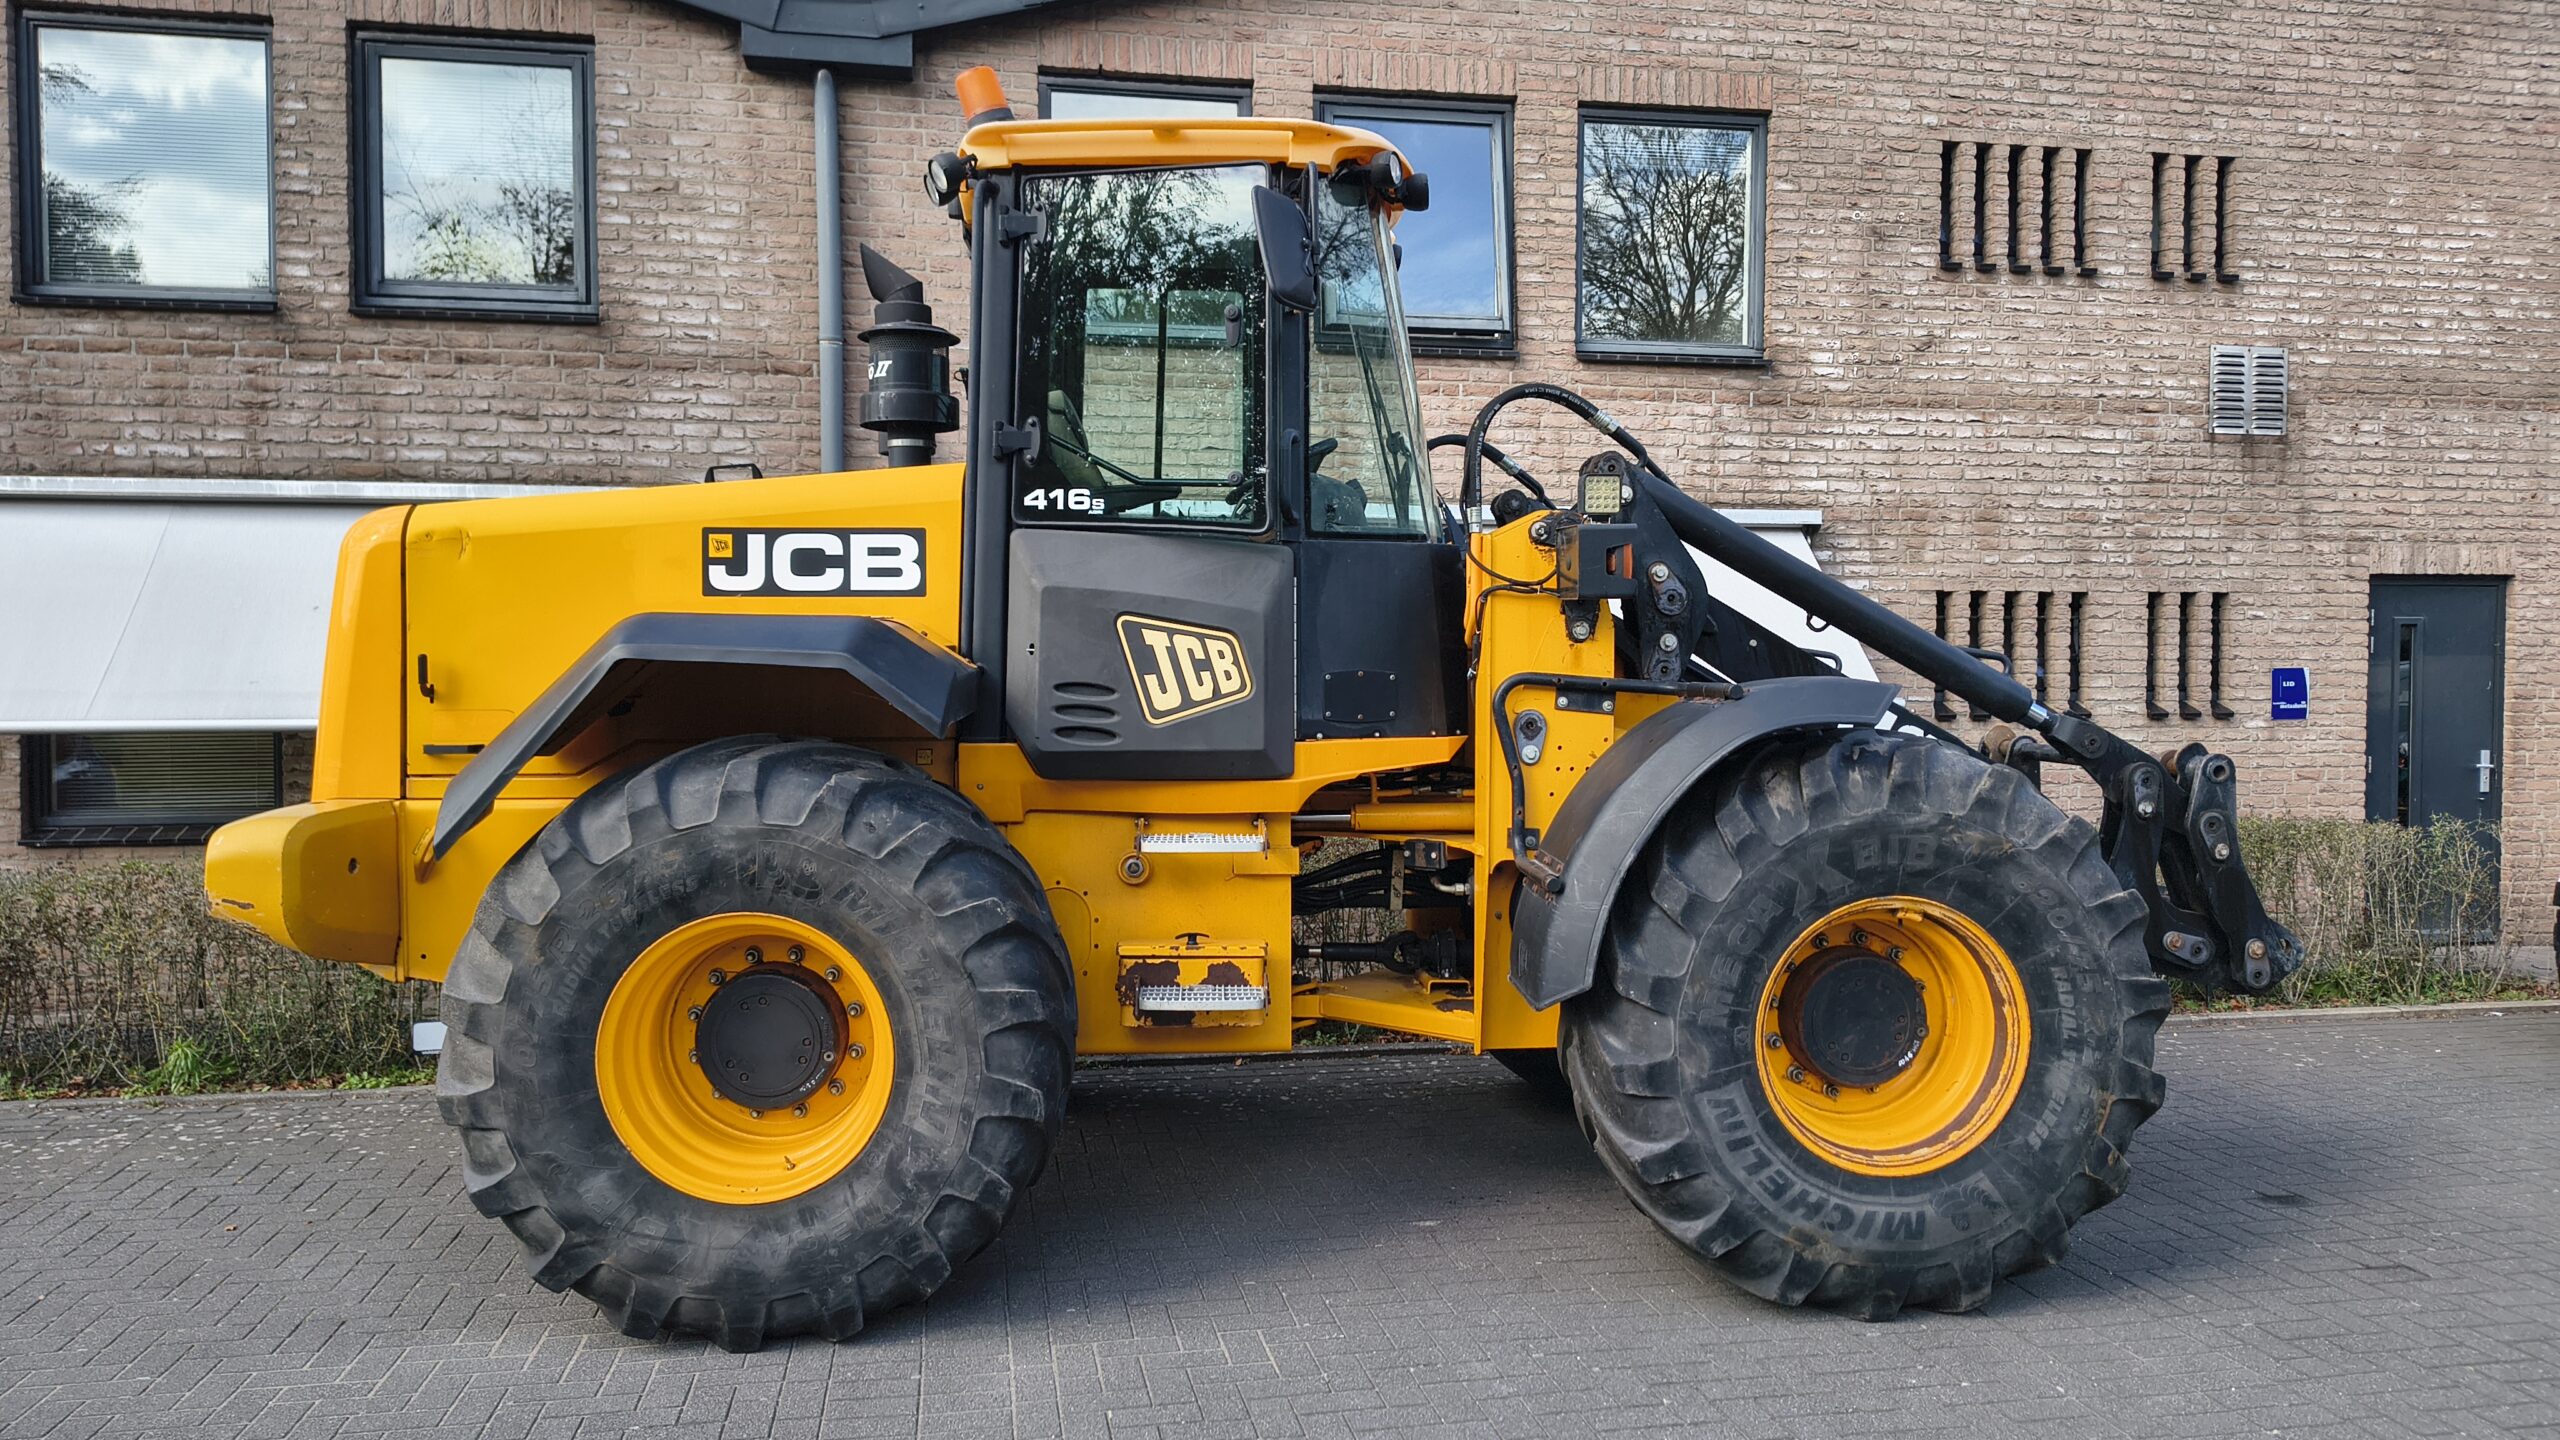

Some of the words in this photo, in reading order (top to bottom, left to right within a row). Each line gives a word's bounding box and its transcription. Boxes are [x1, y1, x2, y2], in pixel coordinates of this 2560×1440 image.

[708, 533, 922, 592] JCB
[1140, 628, 1242, 712] JCB
[828, 872, 959, 1141] MICHELIN
[1701, 1086, 1930, 1243] MICHELIN
